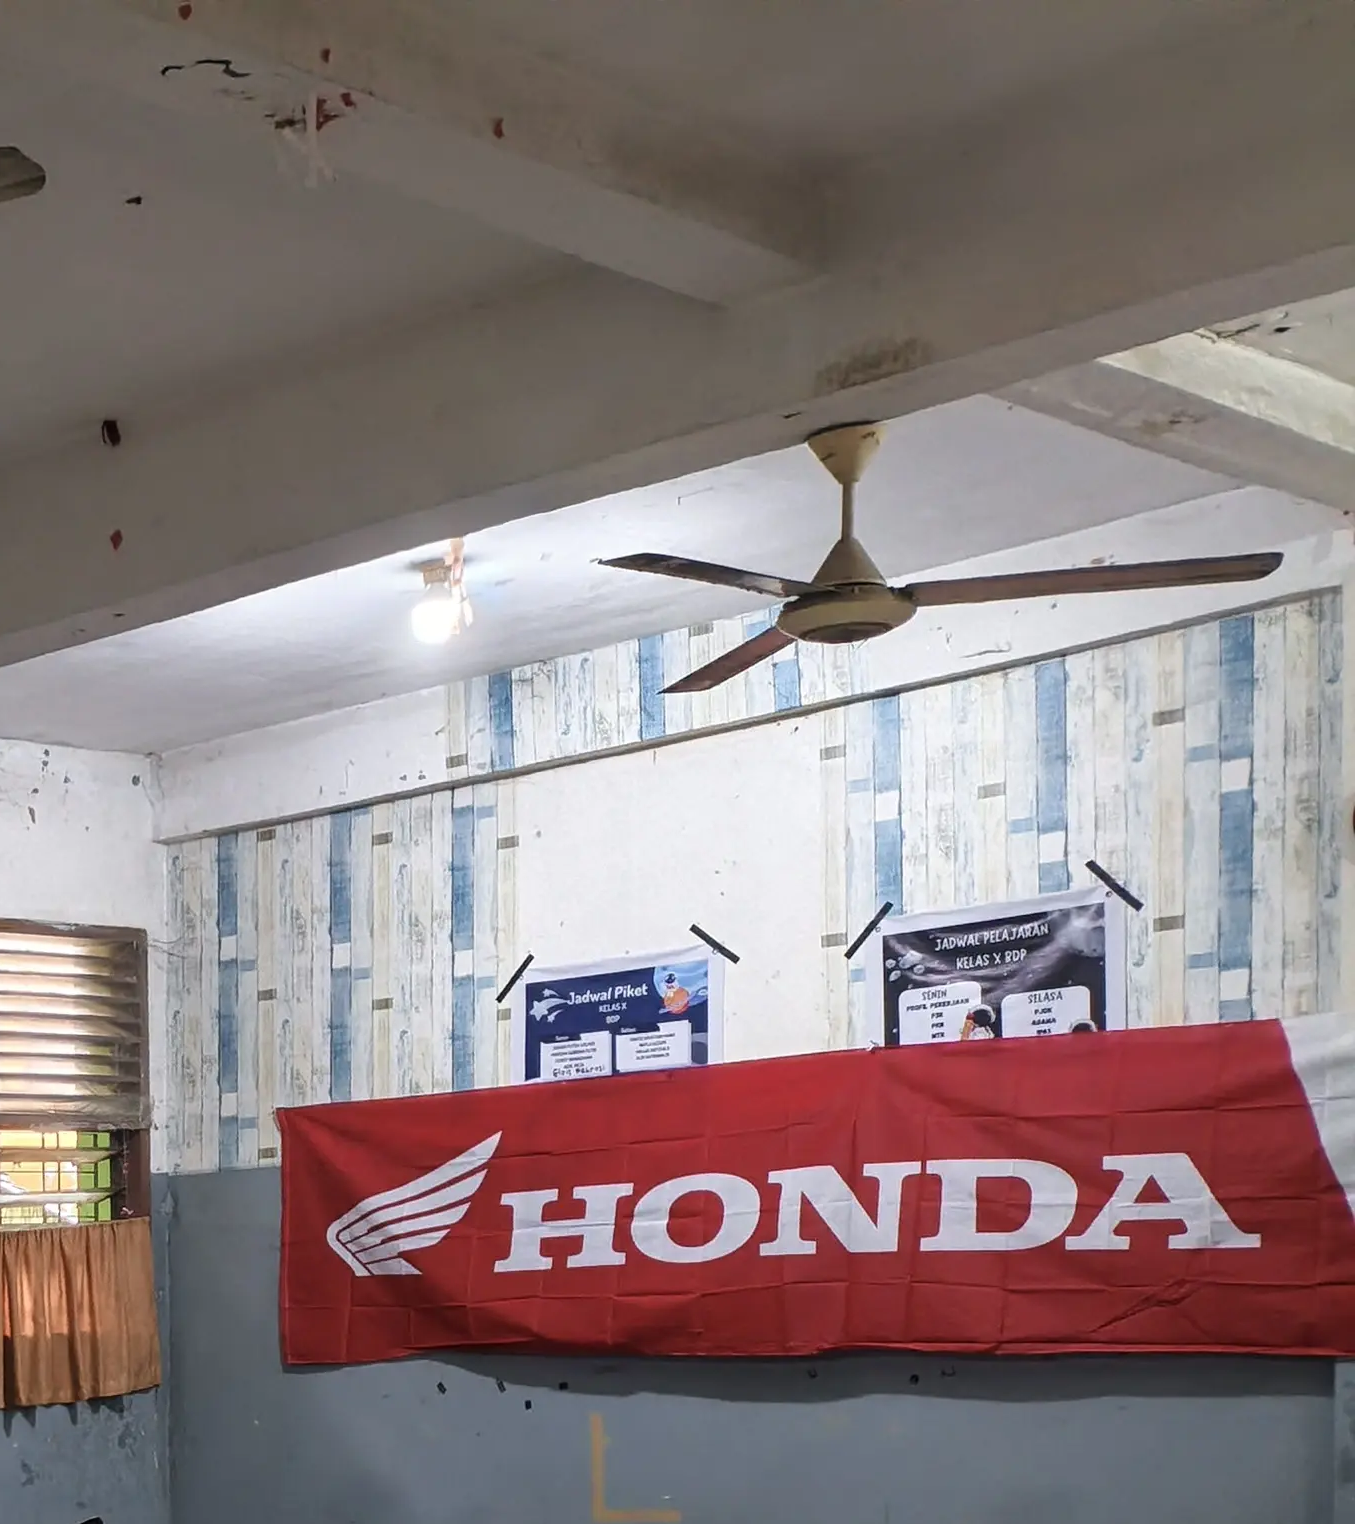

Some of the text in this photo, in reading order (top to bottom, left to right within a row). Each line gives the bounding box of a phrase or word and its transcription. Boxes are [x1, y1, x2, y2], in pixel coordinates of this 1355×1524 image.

[935, 923, 1049, 951] JADWAL PELAJARAN
[956, 948, 1027, 970] KELAS X BDP
[567, 983, 648, 1005] Jadwal Piket
[922, 989, 947, 1000] SENIN
[1028, 991, 1063, 1004] SELASA
[599, 1003, 620, 1013] KELAS
[493, 1153, 1261, 1273] HONDA
